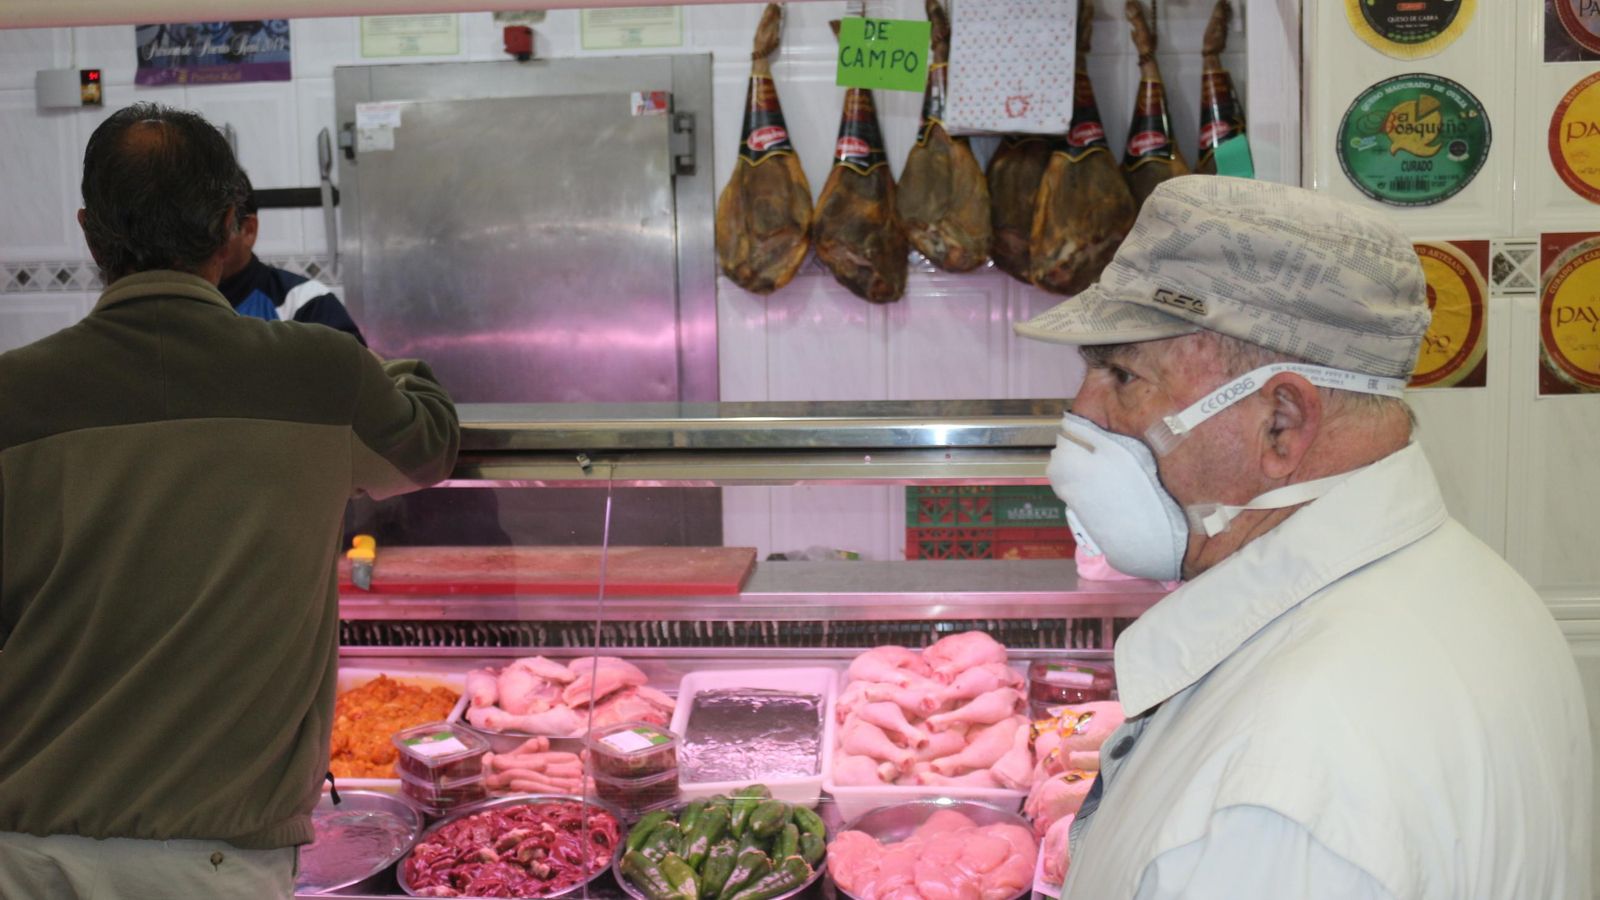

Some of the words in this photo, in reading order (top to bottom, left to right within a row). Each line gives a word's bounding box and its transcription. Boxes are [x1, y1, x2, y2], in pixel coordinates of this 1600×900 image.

[864, 20, 891, 40] DE
[840, 46, 919, 74] CAMPO
[1433, 84, 1446, 93] DE
[1445, 89, 1469, 109] OVEJA
[1401, 160, 1433, 172] CURADO
[1550, 264, 1573, 294] CURADO
